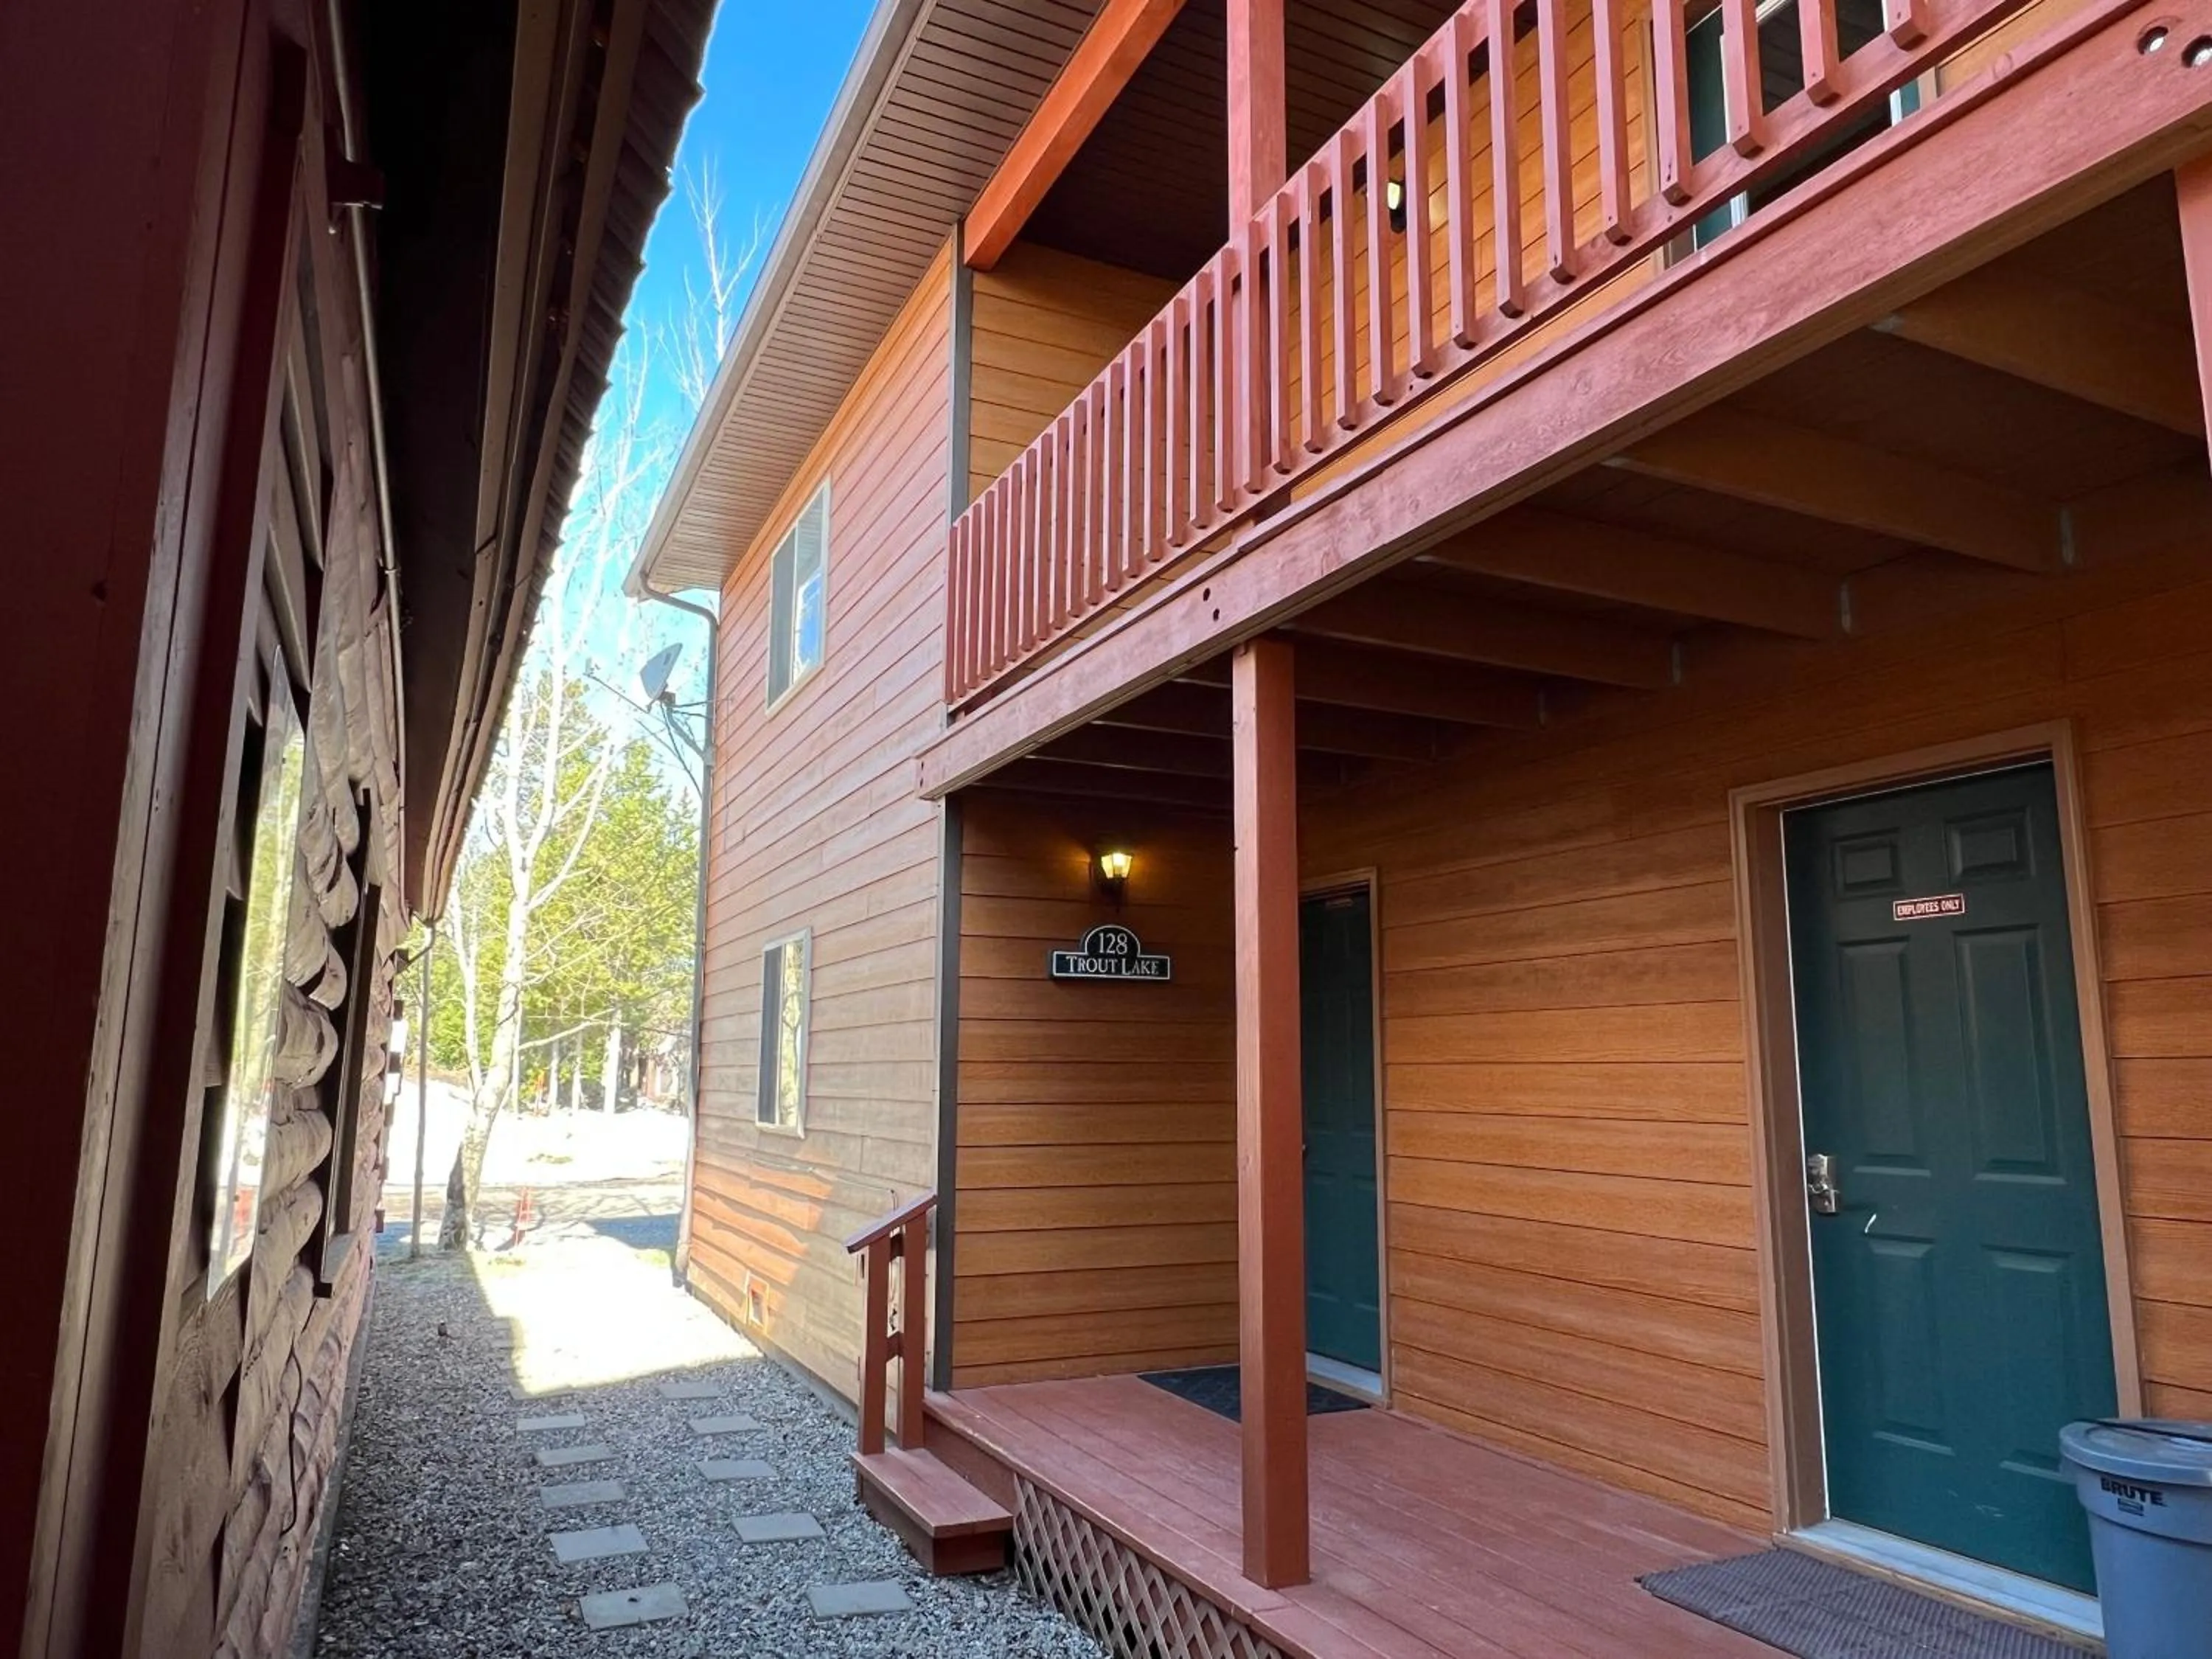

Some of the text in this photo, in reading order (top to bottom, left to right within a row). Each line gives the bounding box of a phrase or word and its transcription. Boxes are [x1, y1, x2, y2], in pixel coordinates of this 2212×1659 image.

[1897, 899, 1960, 916] EMPLOYEES ONLY
[1099, 932, 1128, 955] 128
[1065, 956, 1160, 975] TROUT LAKE
[2101, 1476, 2164, 1506] BRUTE
